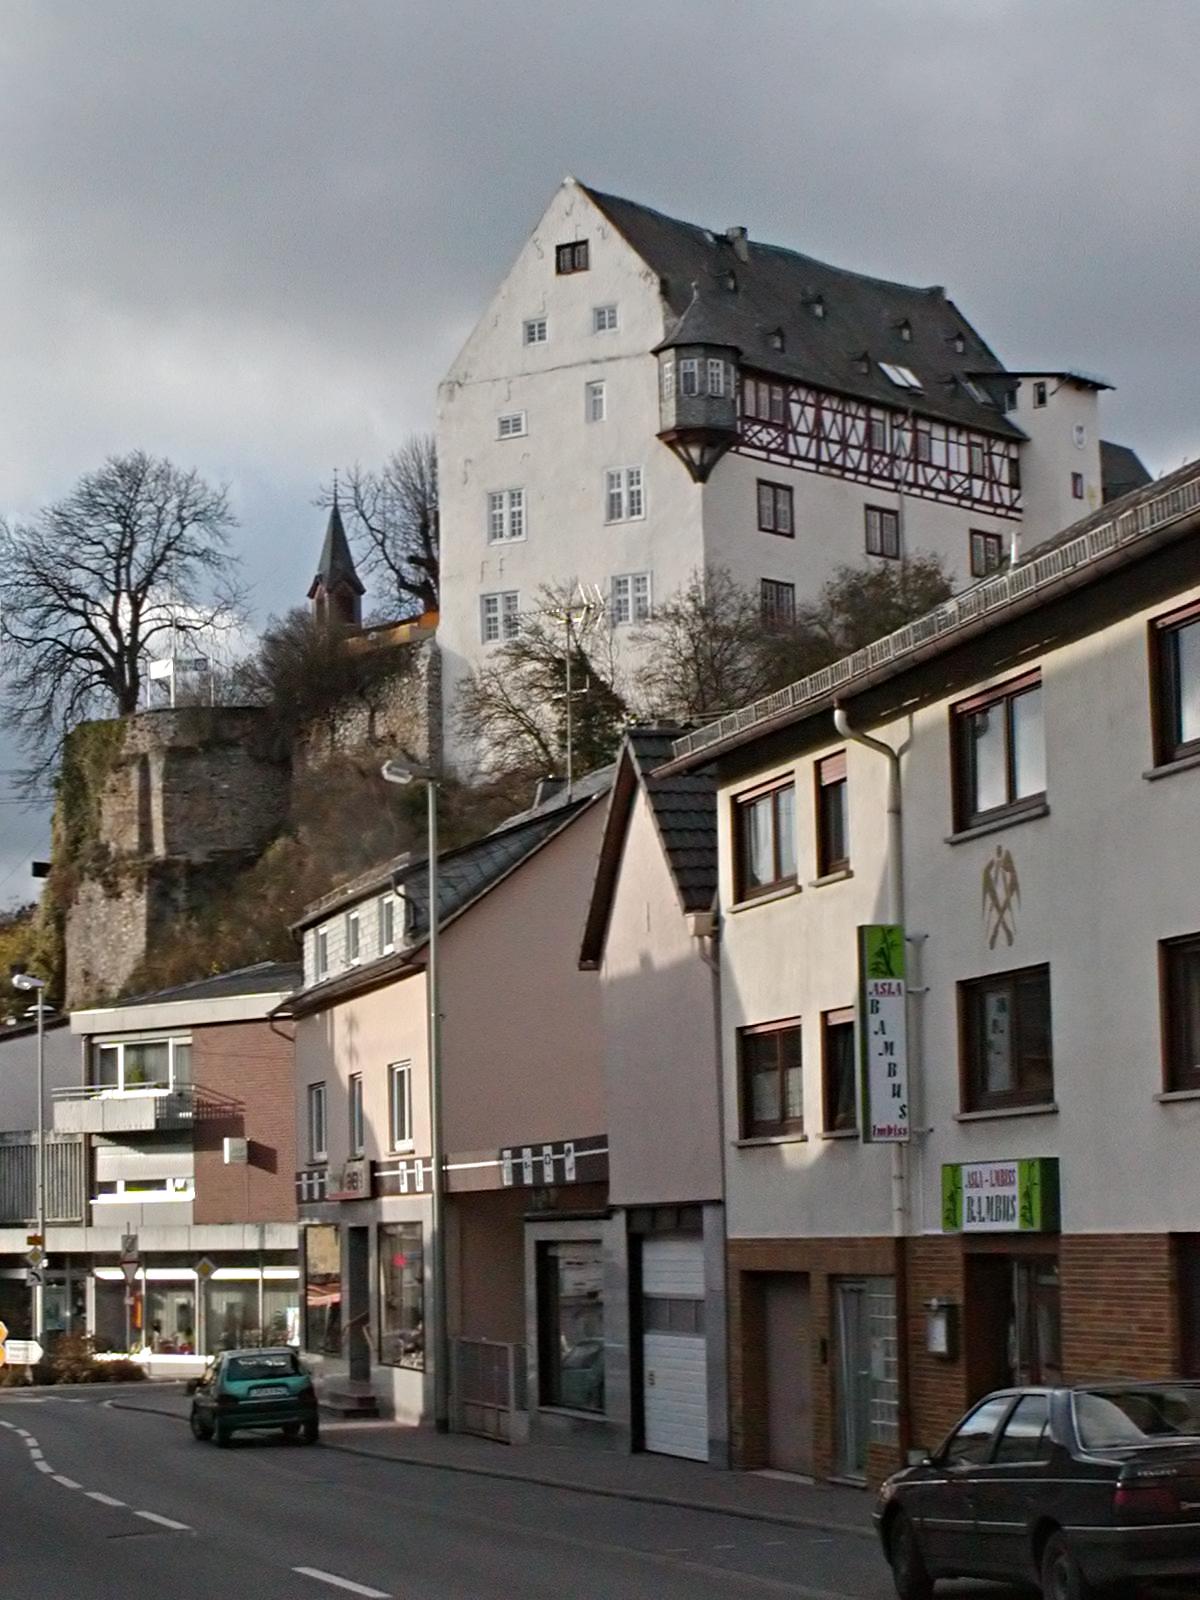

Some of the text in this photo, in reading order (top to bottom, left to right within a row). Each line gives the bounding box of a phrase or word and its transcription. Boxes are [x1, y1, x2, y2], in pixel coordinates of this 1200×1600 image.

[869, 982, 902, 997] ASIA
[872, 1125, 908, 1138] Imbiss
[966, 1195, 1016, 1223] BAMBUS
